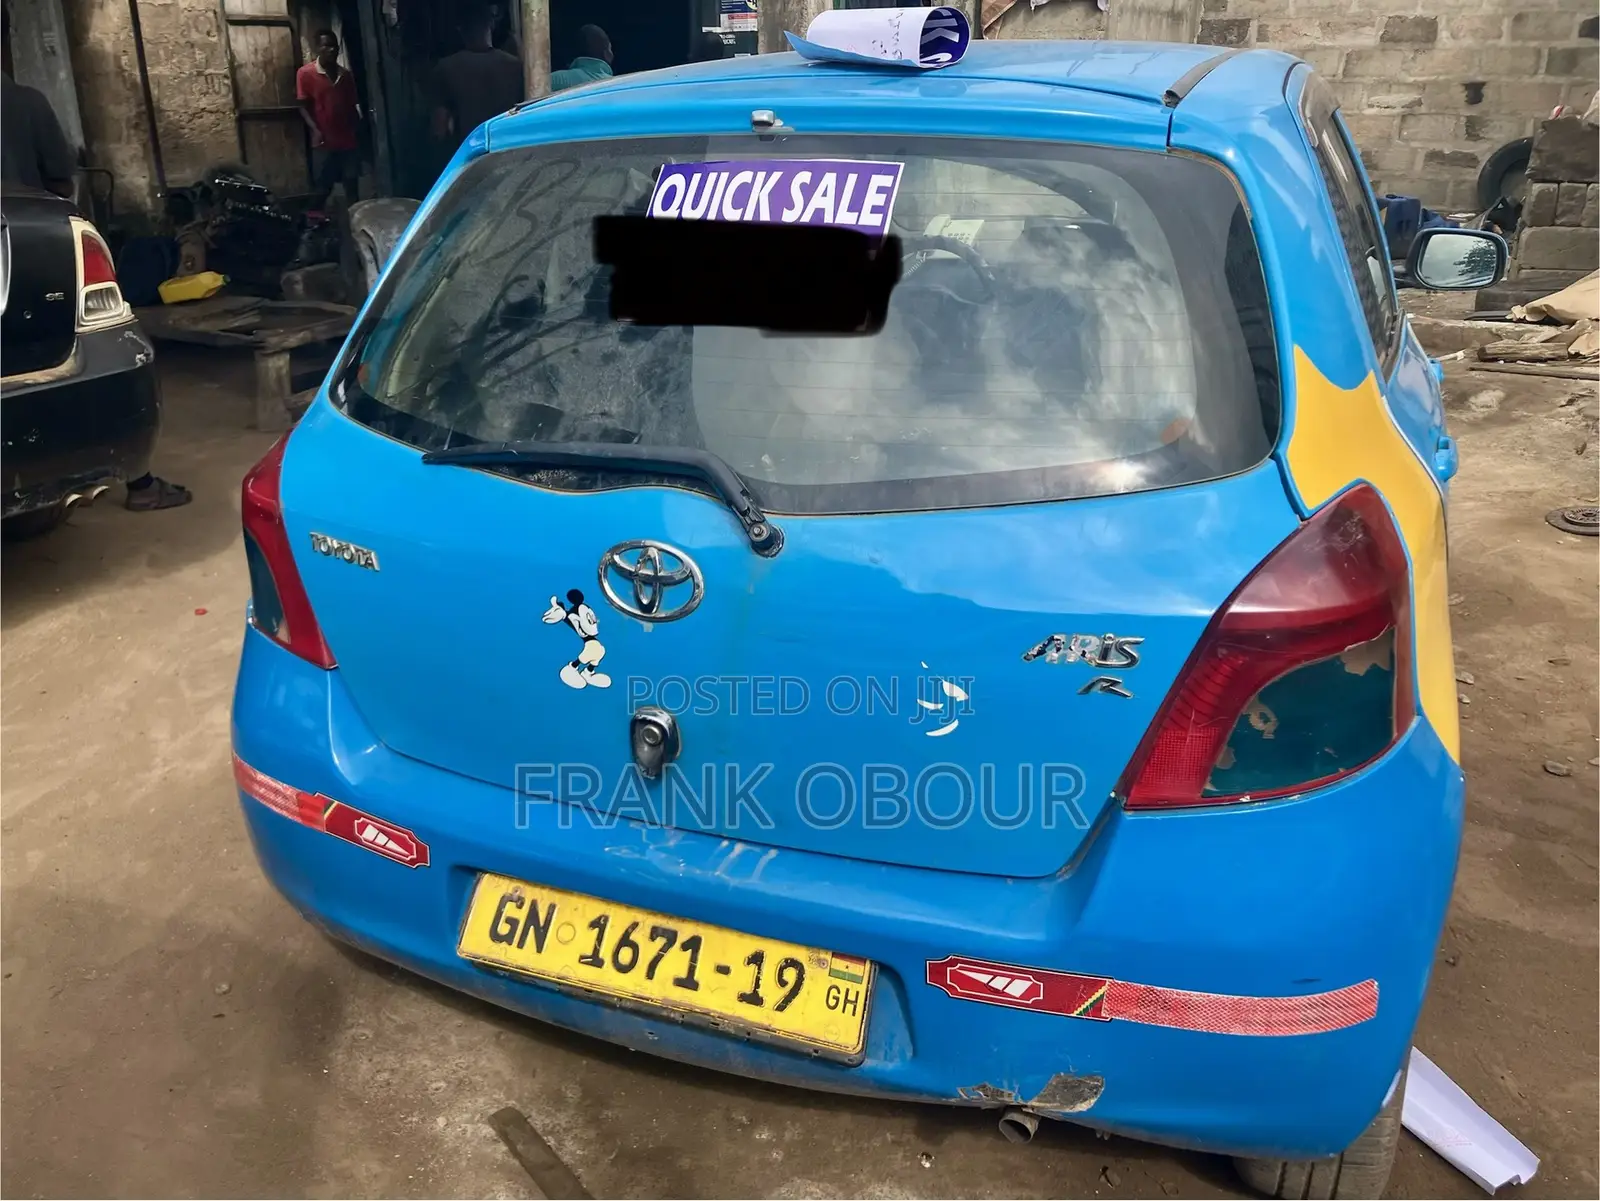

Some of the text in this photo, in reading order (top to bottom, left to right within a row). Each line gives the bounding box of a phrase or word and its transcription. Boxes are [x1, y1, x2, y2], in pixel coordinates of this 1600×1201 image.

[652, 170, 783, 222] QUICK
[781, 171, 894, 227] SALE
[309, 532, 380, 572] TOYOTA
[489, 891, 806, 1012] GN 1671-19
[825, 985, 861, 1017] GH
